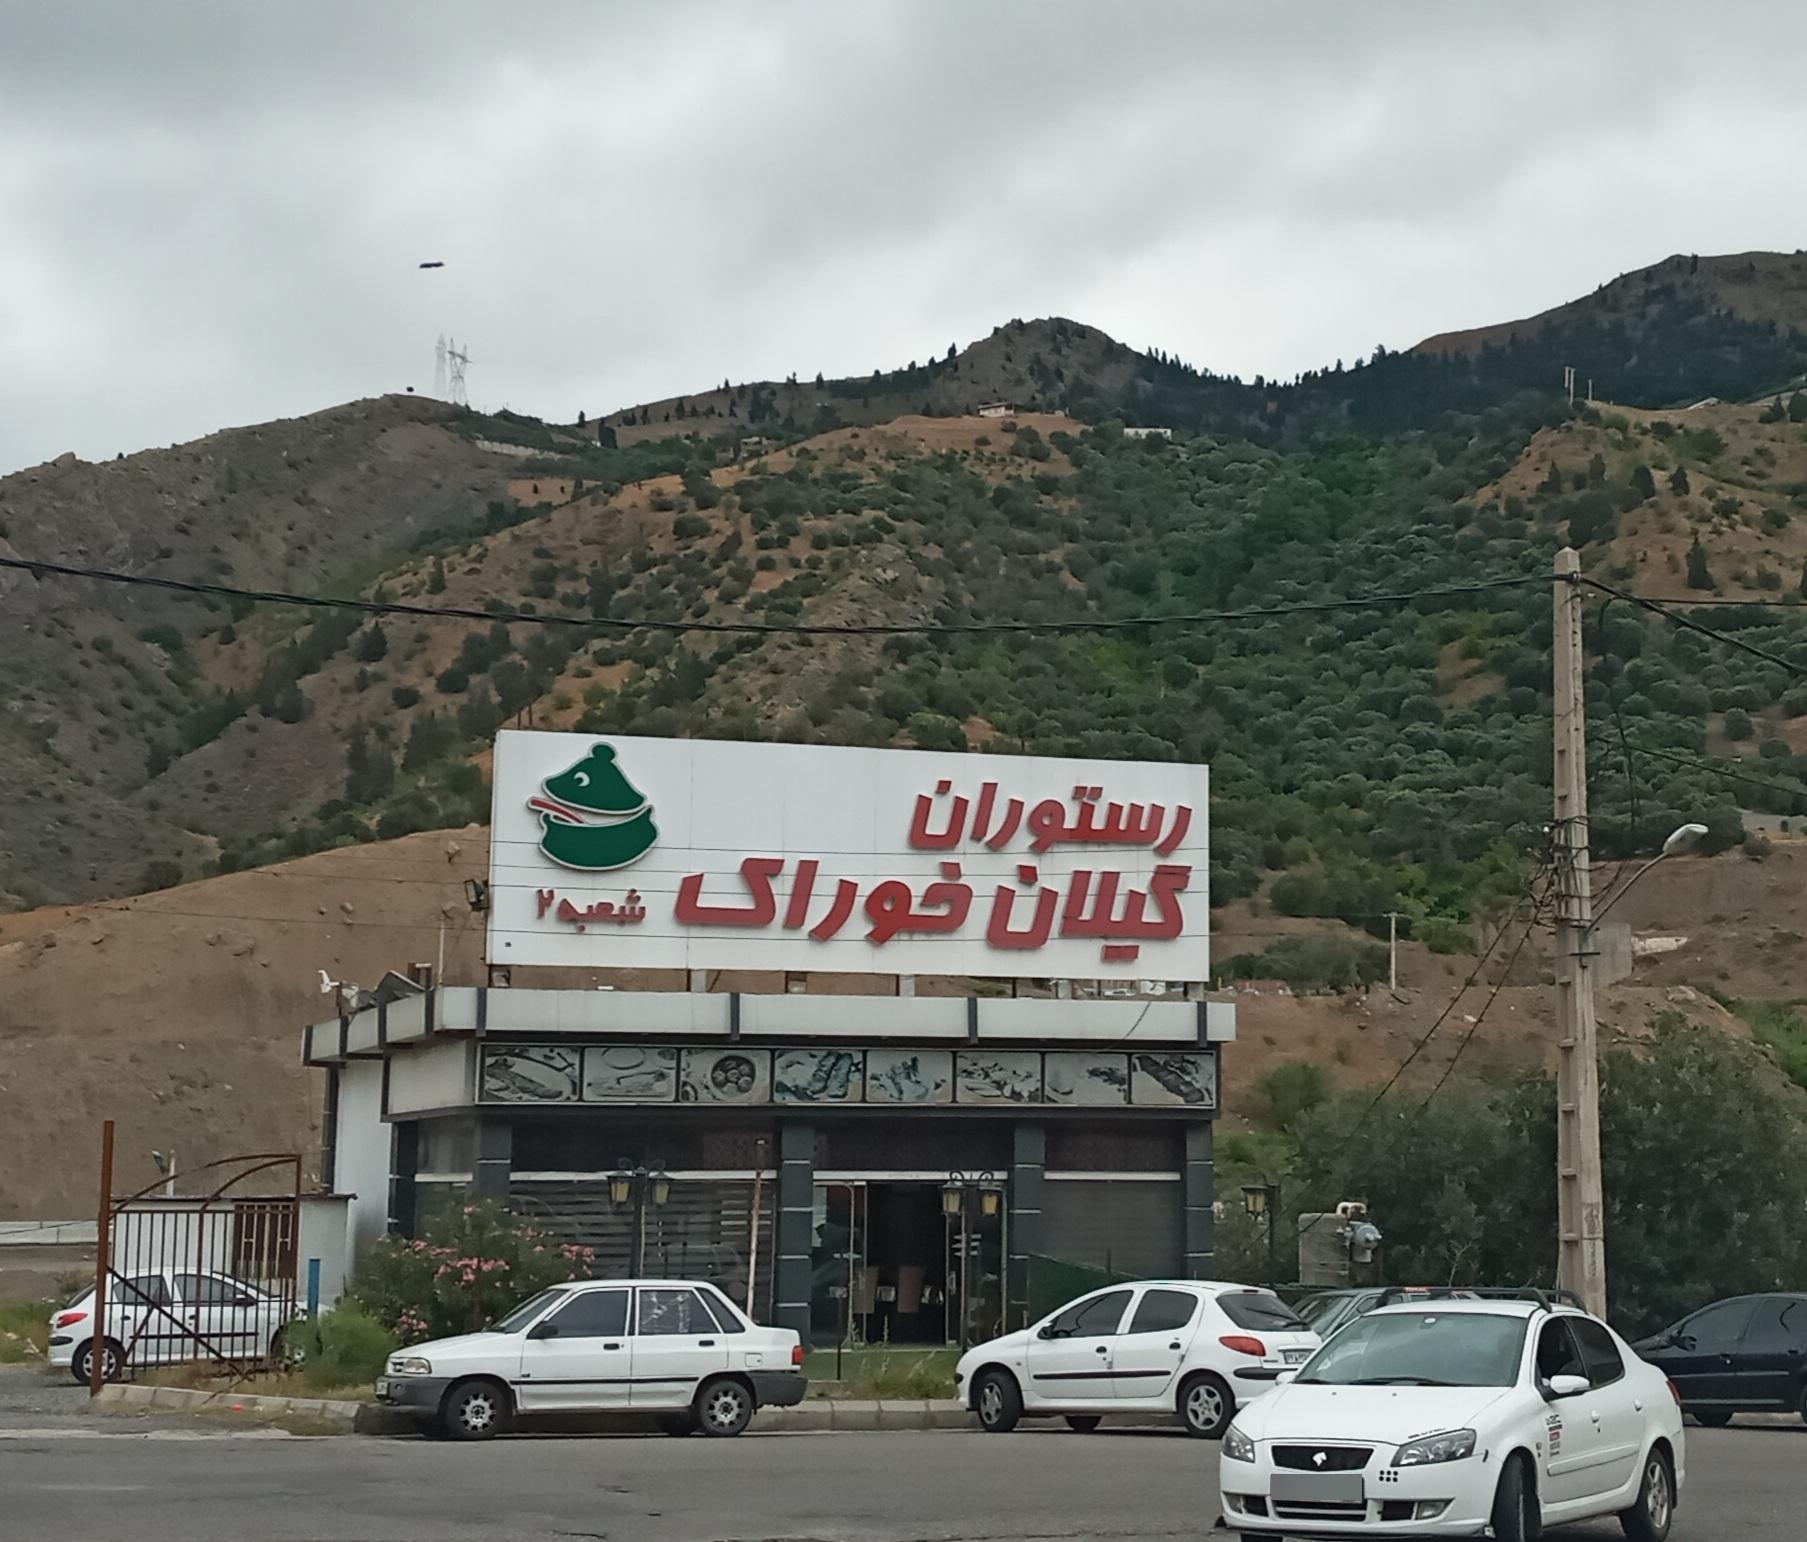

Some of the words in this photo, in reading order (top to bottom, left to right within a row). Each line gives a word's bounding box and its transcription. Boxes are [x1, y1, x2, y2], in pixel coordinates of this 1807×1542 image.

[908, 779, 1193, 857] رستوران
[556, 888, 647, 933] شعبه
[674, 857, 974, 945] خوراک
[985, 864, 1193, 962] گیلان
